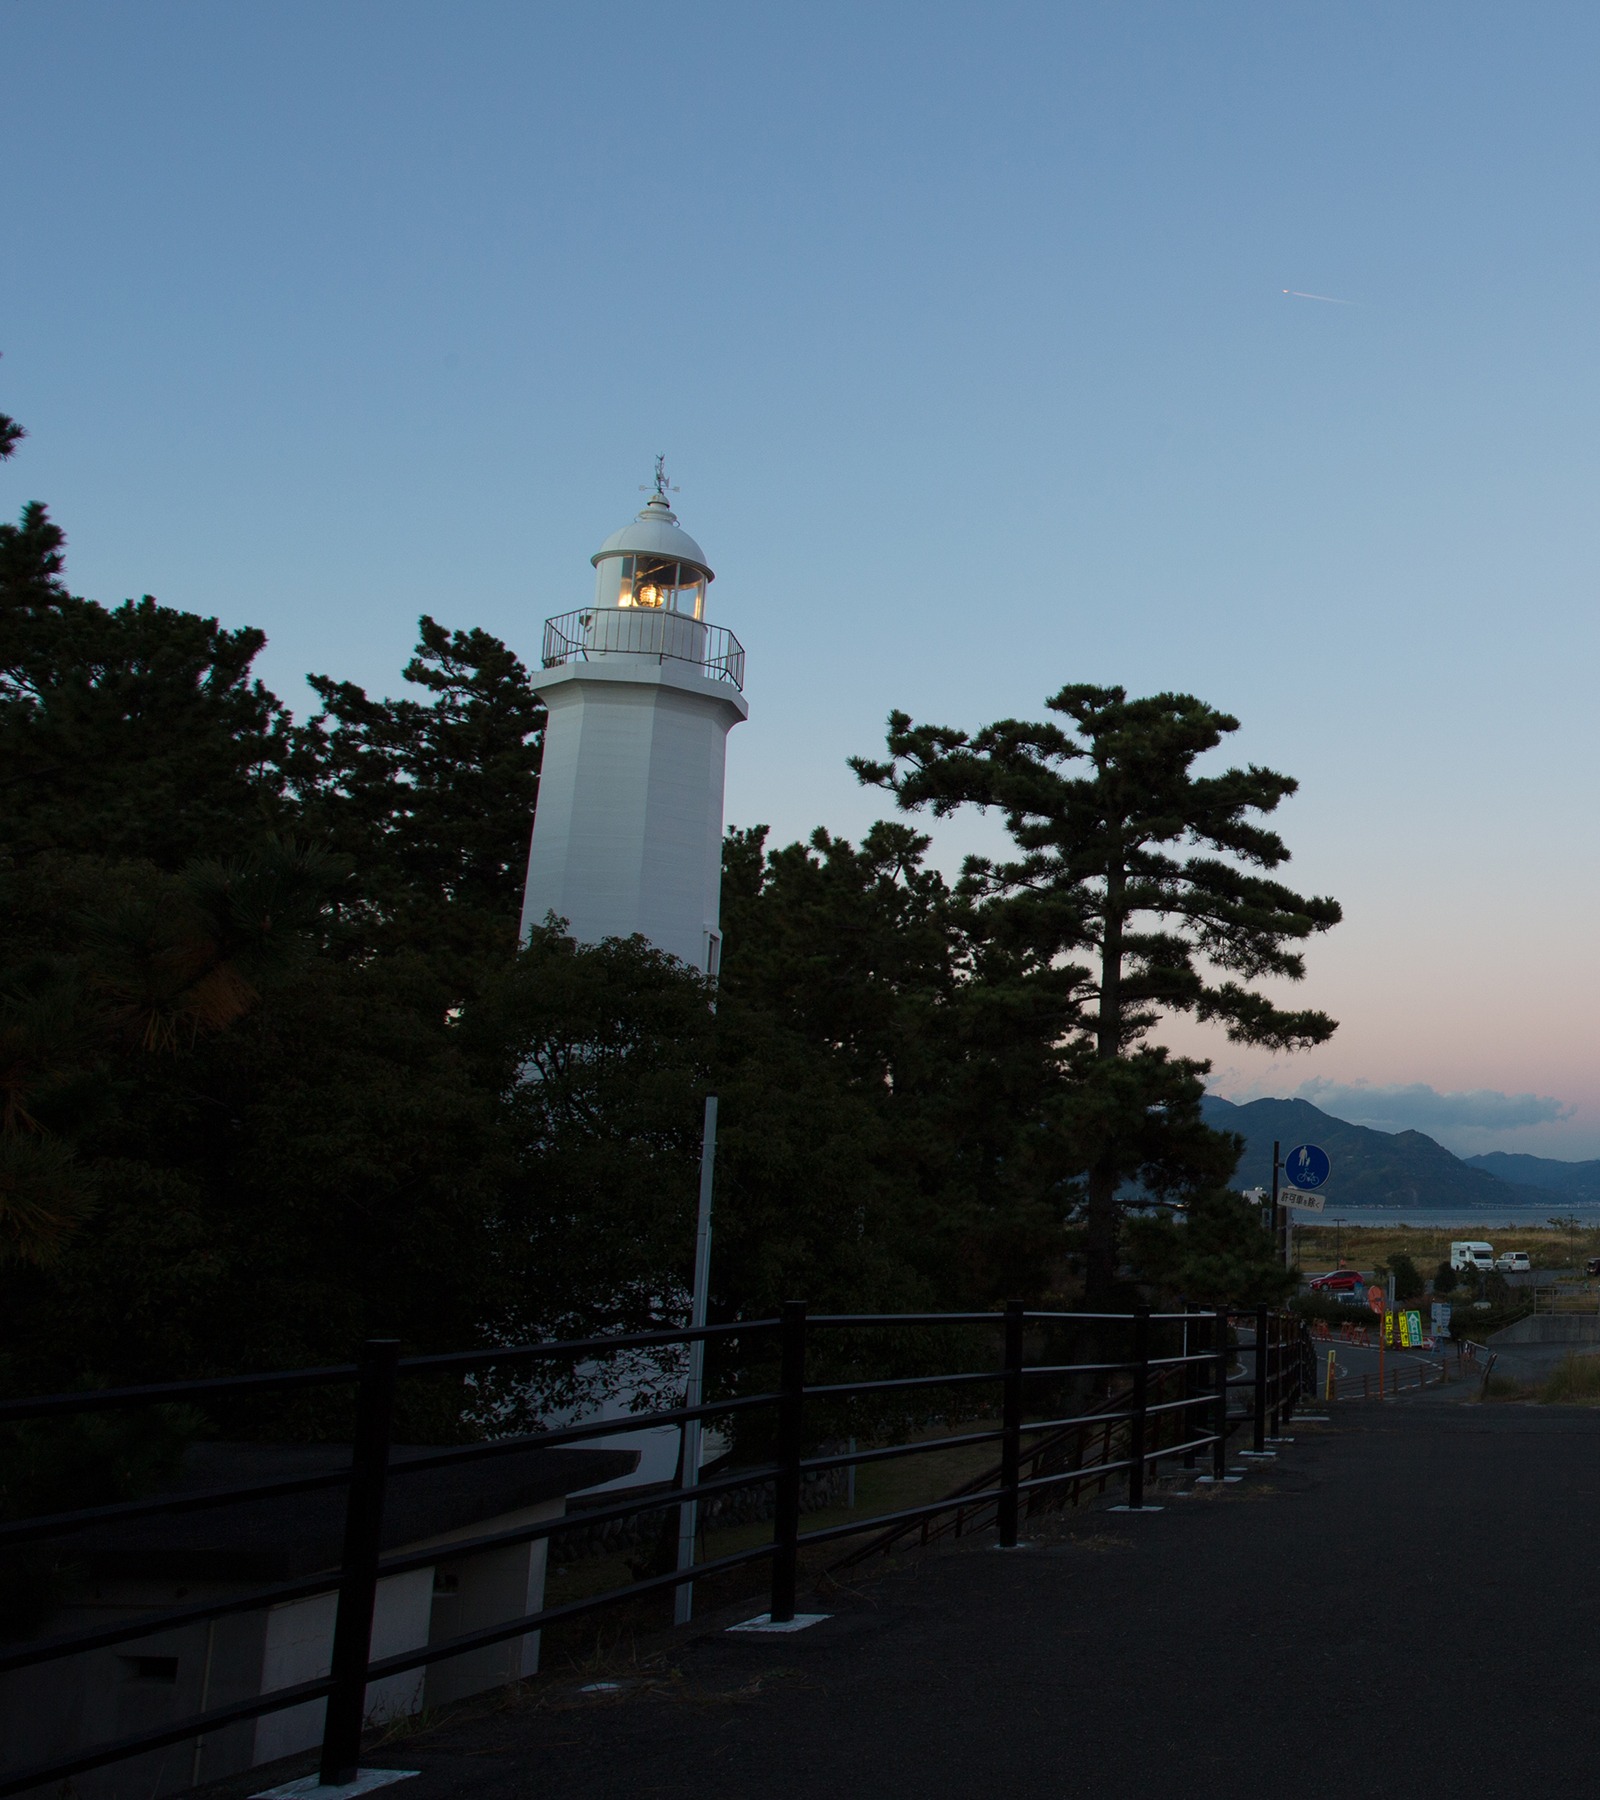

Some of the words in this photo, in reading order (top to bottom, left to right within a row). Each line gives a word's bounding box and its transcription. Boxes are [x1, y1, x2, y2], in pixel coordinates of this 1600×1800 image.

[1281, 1191, 1320, 1209] 許可車を除く
